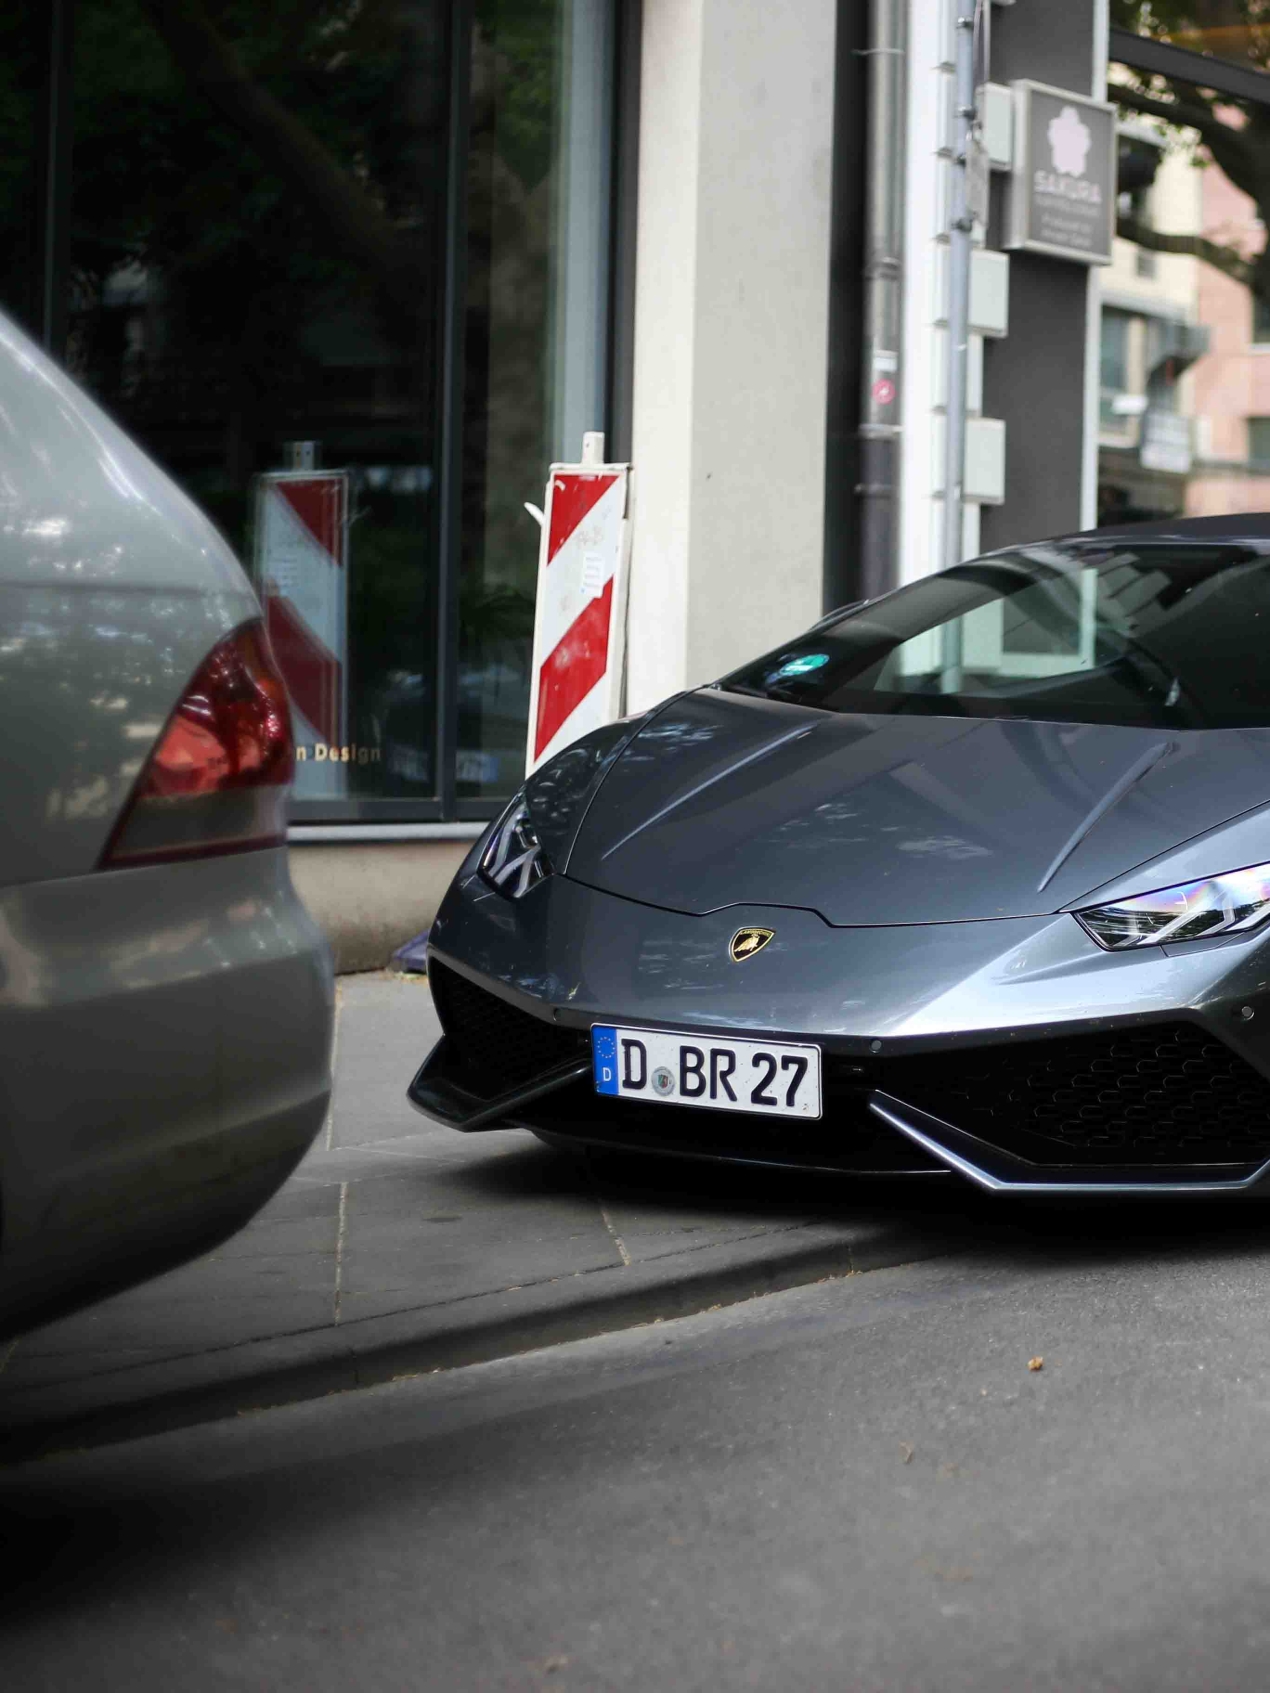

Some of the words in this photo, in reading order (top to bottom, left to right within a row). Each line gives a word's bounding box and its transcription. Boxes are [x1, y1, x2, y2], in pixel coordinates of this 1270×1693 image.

[315, 743, 380, 765] Design
[602, 1067, 612, 1082] D
[621, 1038, 647, 1090] D
[679, 1045, 738, 1102] BR
[751, 1052, 808, 1107] 27
